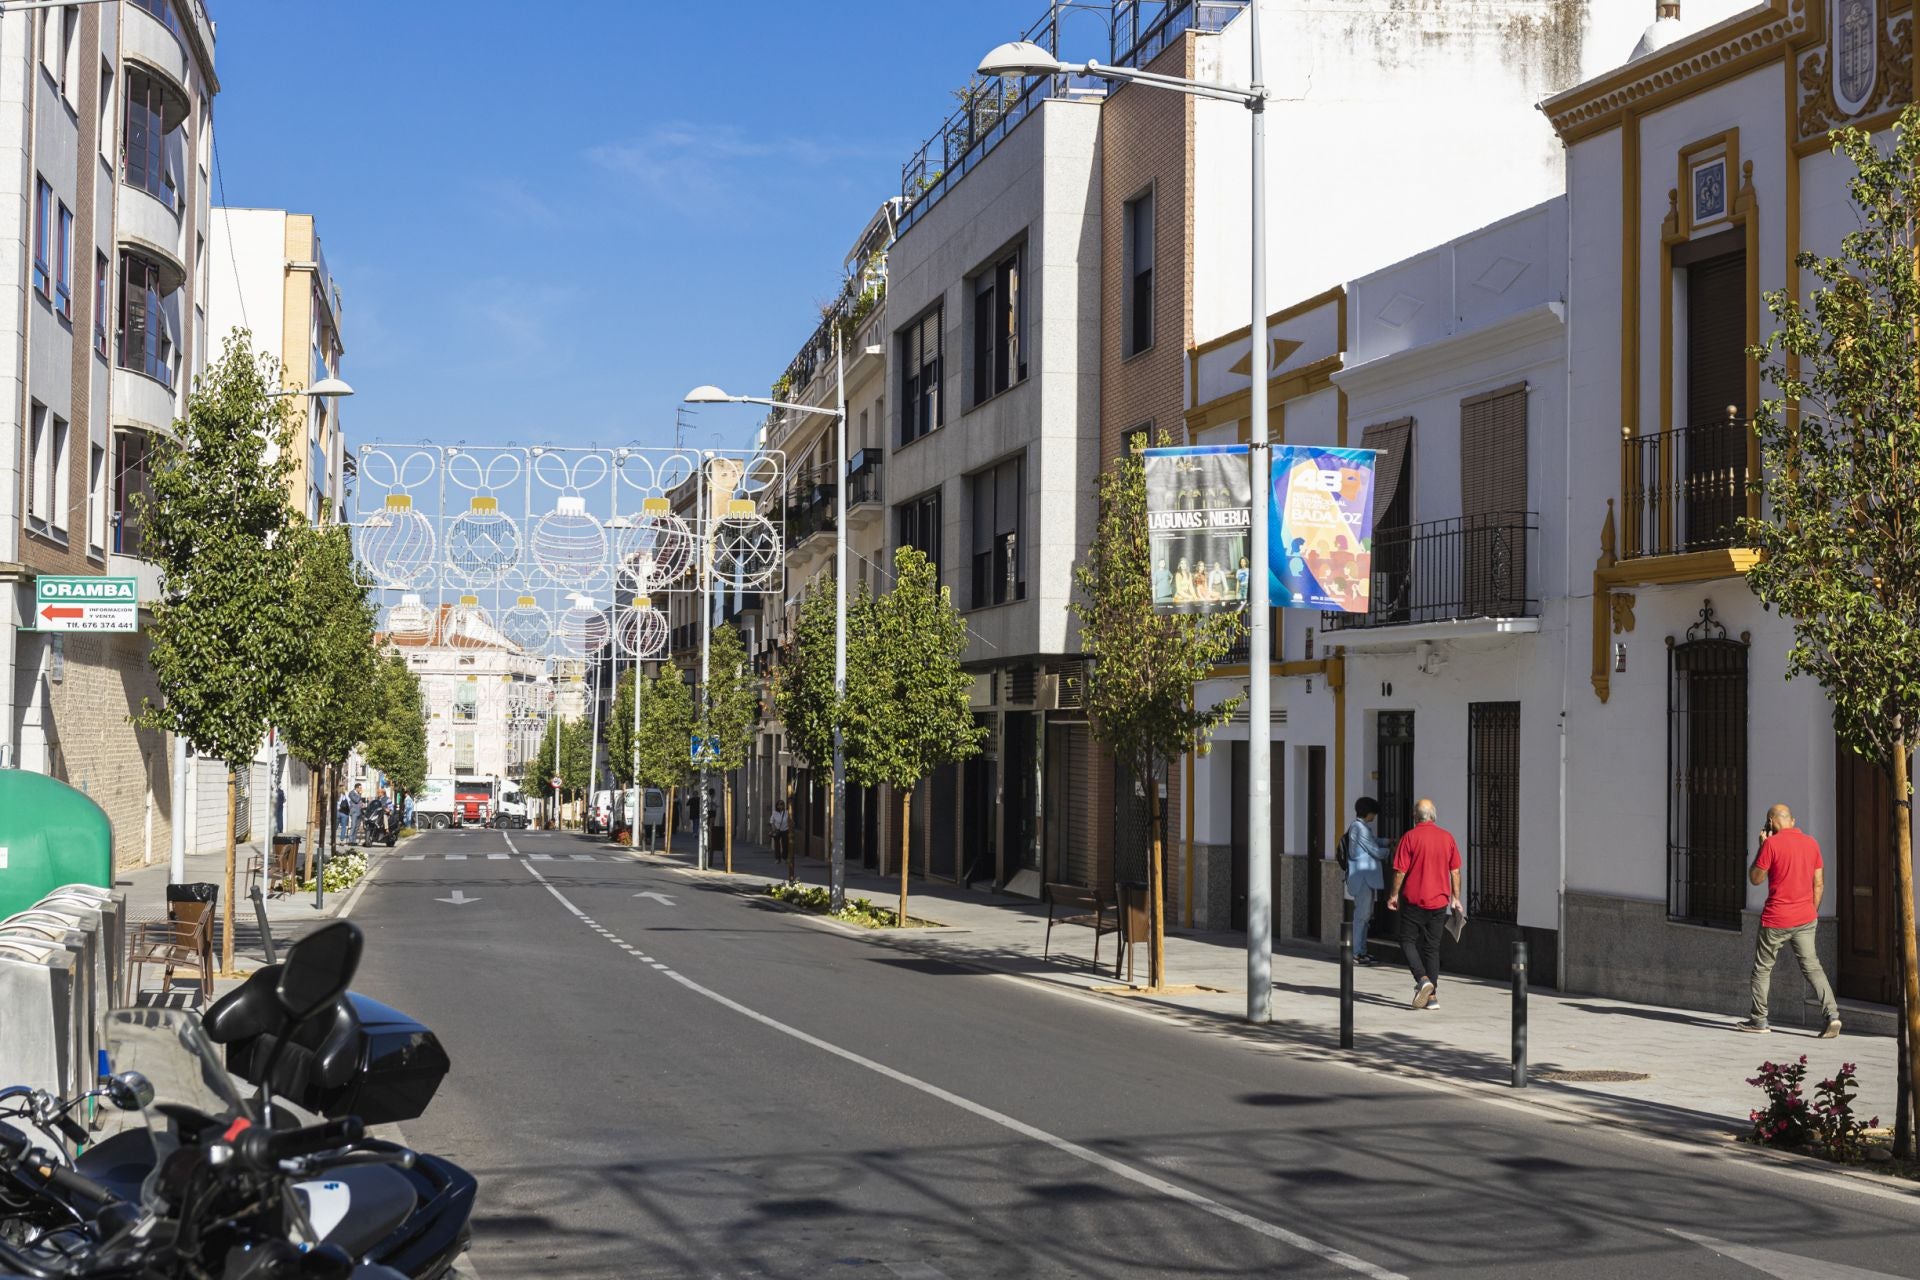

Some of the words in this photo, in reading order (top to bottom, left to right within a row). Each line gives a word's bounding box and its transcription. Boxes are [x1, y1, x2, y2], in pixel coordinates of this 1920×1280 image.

[1294, 469, 1342, 492] 48
[1148, 512, 1202, 529] LAGUNAS
[1210, 510, 1250, 527] NIEBLA
[42, 583, 132, 596] ORAMBA
[1381, 681, 1392, 697] 10
